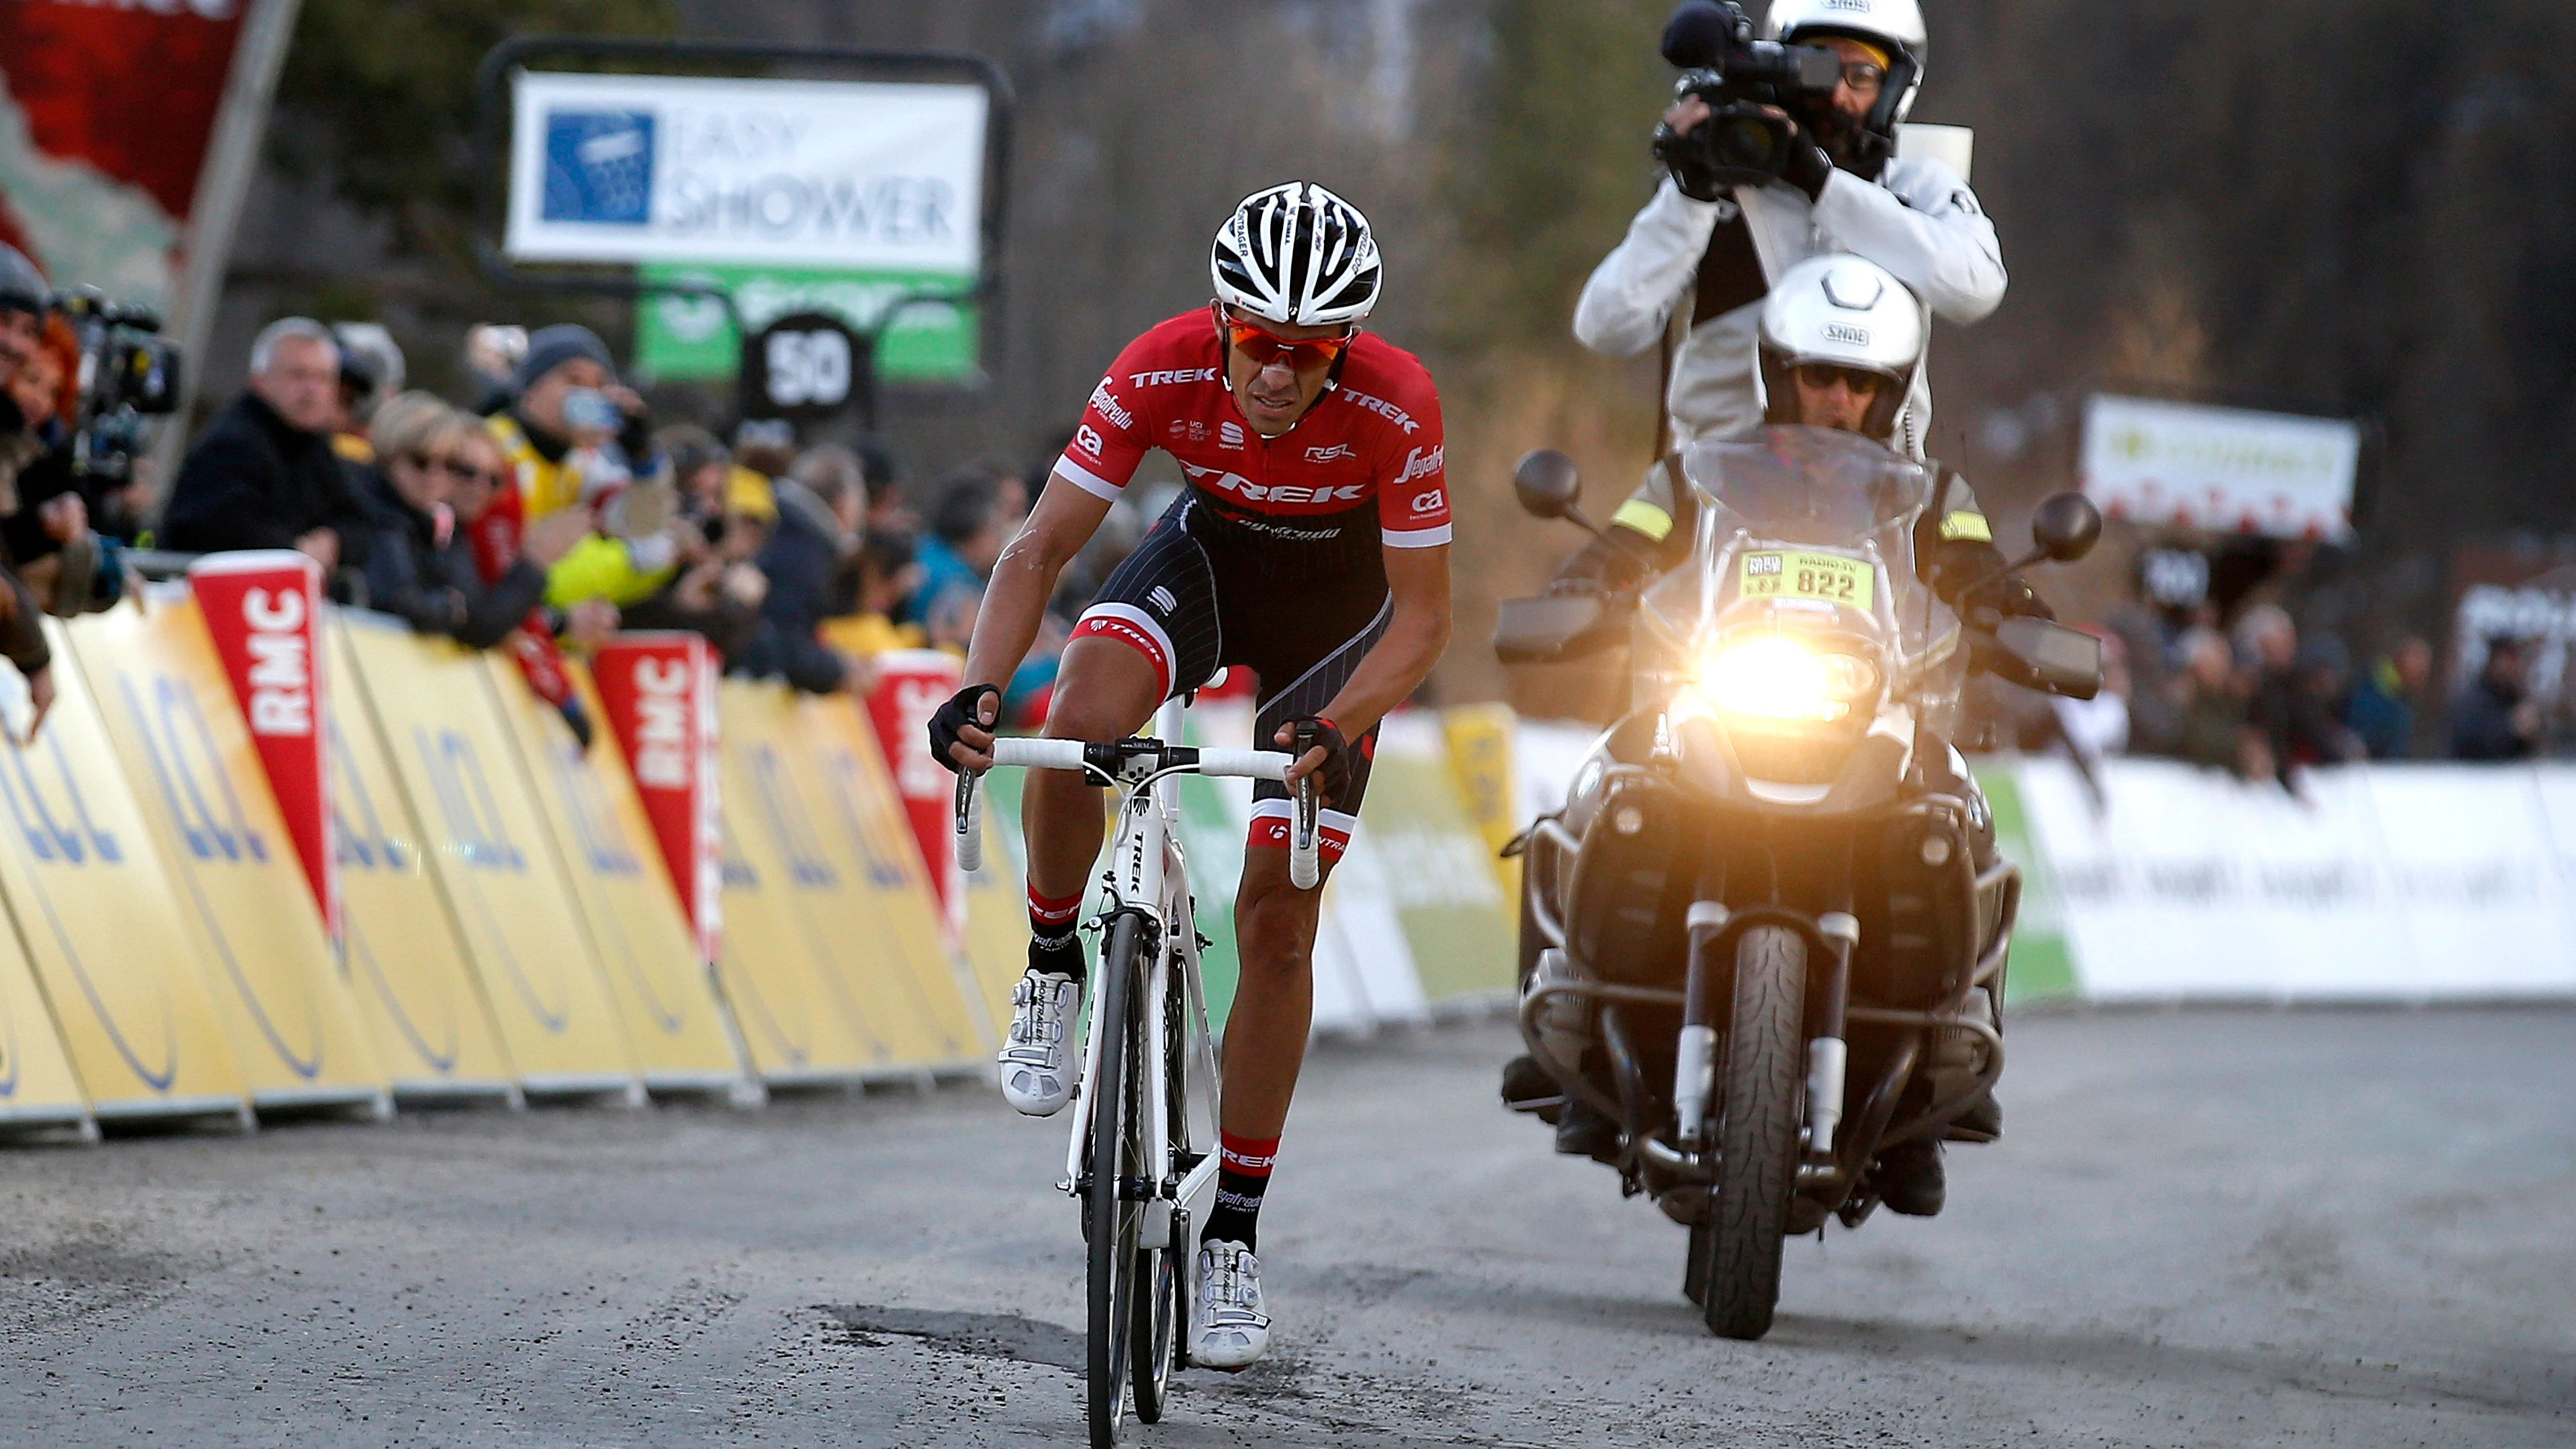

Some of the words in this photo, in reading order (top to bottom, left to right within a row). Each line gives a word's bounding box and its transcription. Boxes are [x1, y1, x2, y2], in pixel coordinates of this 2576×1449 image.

[666, 112, 801, 159] EASY
[665, 173, 955, 241] SHOWER
[765, 328, 852, 405] 50
[1129, 368, 1217, 388] TREK
[1190, 420, 1203, 429] UCI
[1342, 388, 1420, 435] TREK
[1077, 424, 1103, 456] ca
[1304, 444, 1356, 459] RSL
[1172, 459, 1366, 504] TREK
[1412, 489, 1443, 512] ca
[1797, 569, 1855, 601] 822
[243, 586, 313, 736] RMC
[1110, 623, 1163, 662] TREK
[634, 655, 689, 788] RMC
[1131, 831, 1144, 894] TREK
[1034, 980, 1047, 1043] BONTRAGER
